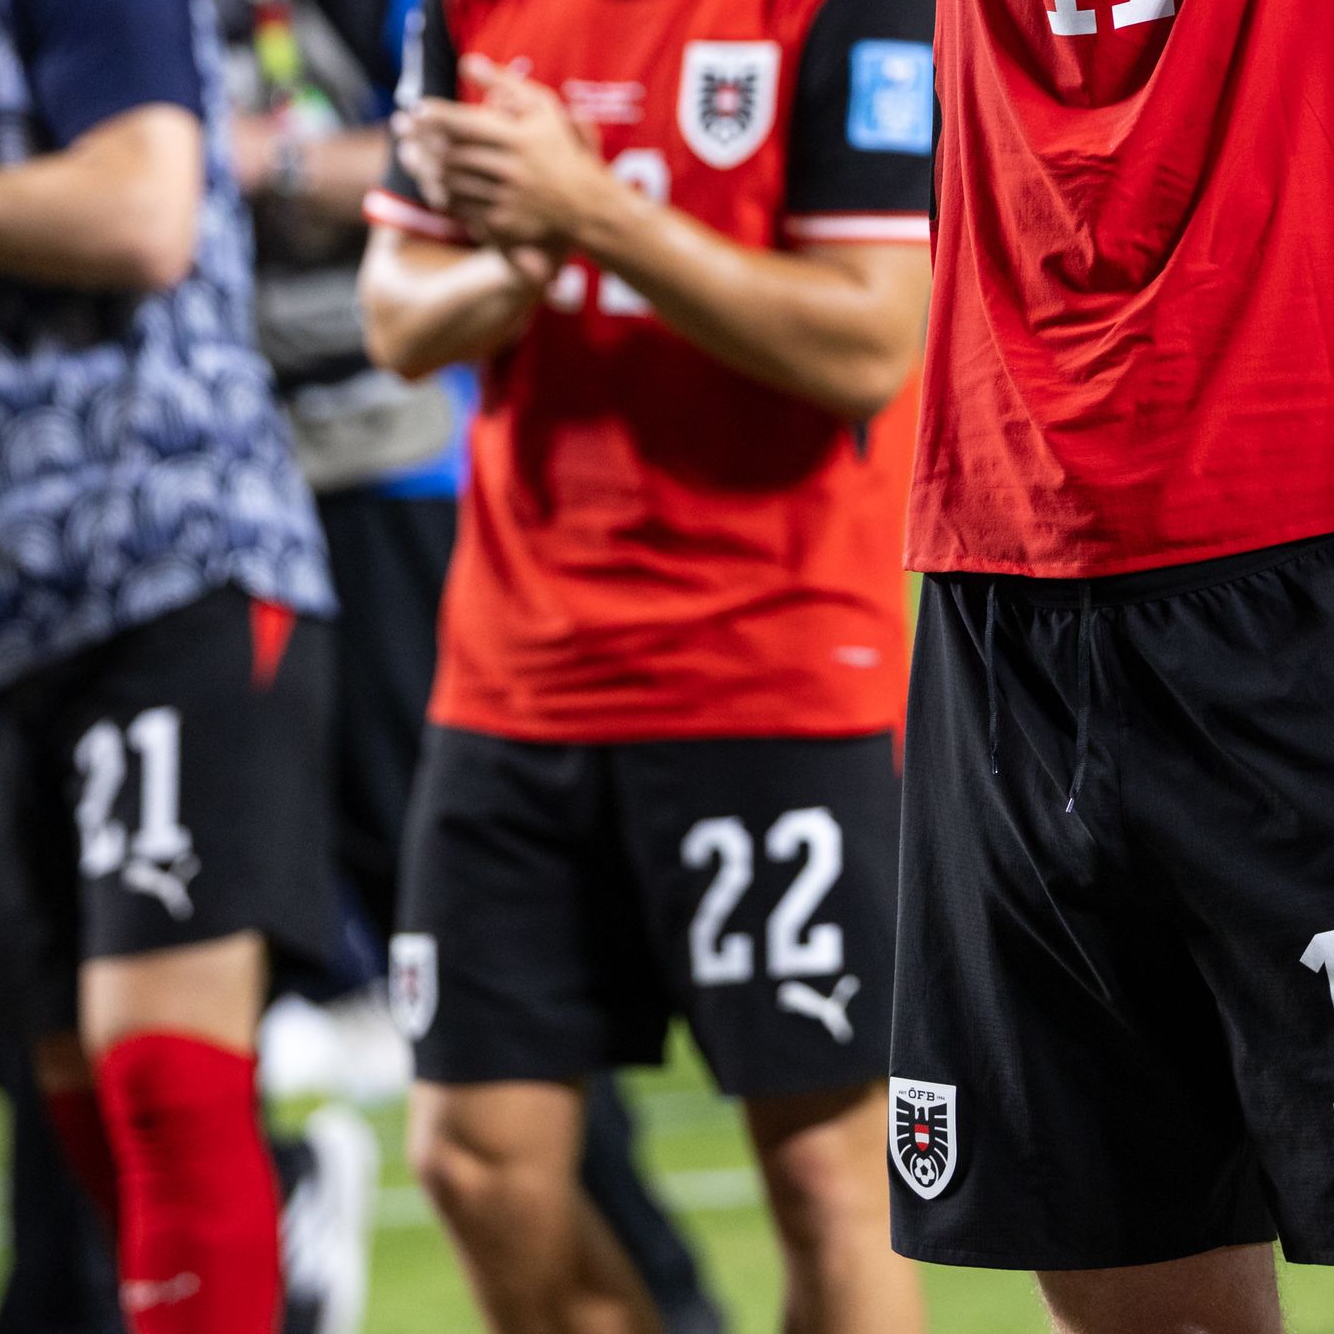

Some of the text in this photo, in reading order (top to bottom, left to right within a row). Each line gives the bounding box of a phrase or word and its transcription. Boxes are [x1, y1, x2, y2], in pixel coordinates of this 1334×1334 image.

[74, 707, 194, 870] 21
[680, 806, 845, 987] 22
[908, 1087, 935, 1102] ÖFB
